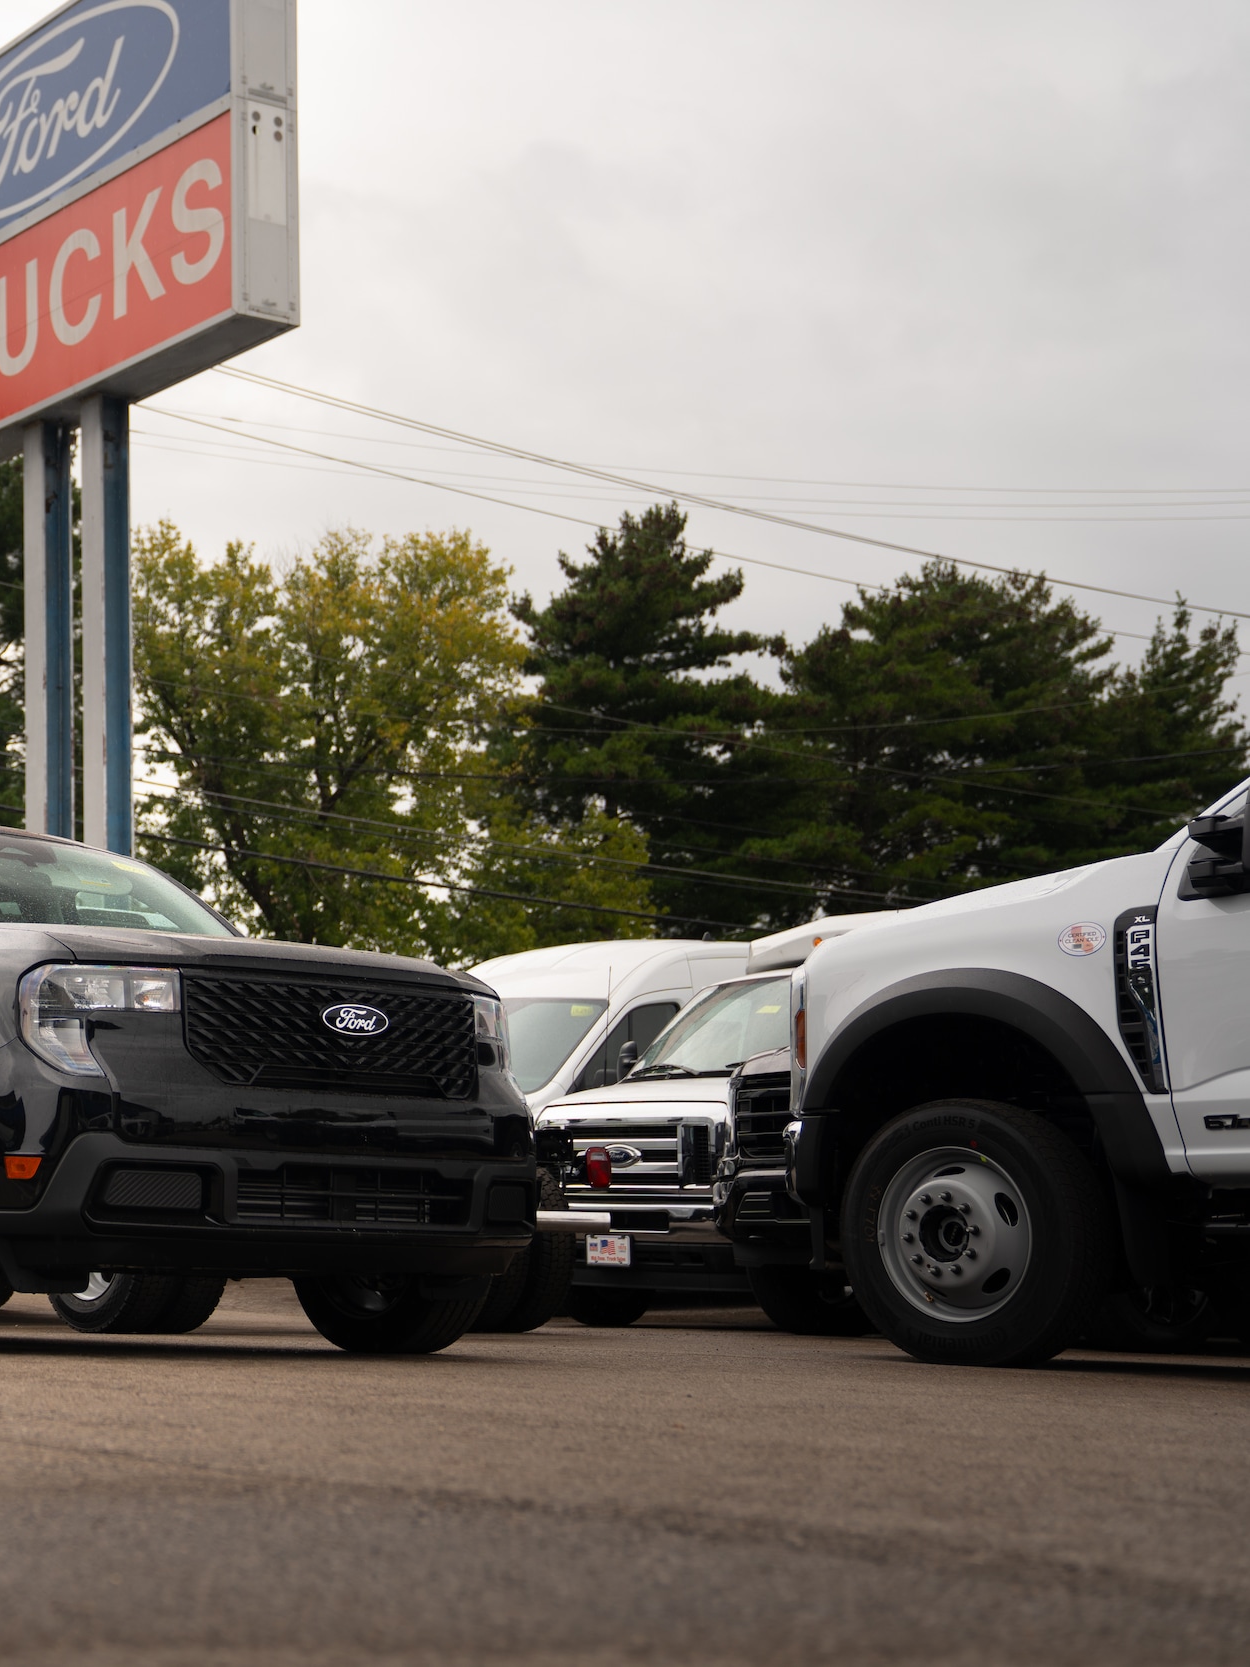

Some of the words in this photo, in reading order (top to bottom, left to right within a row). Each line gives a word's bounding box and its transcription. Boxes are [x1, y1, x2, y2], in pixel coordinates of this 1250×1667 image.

[1134, 915, 1151, 924] XL
[1067, 931, 1097, 939] CERTIFIED
[335, 1007, 377, 1031] Ford
[912, 1115, 941, 1132] Conti
[943, 1114, 967, 1129] HSR
